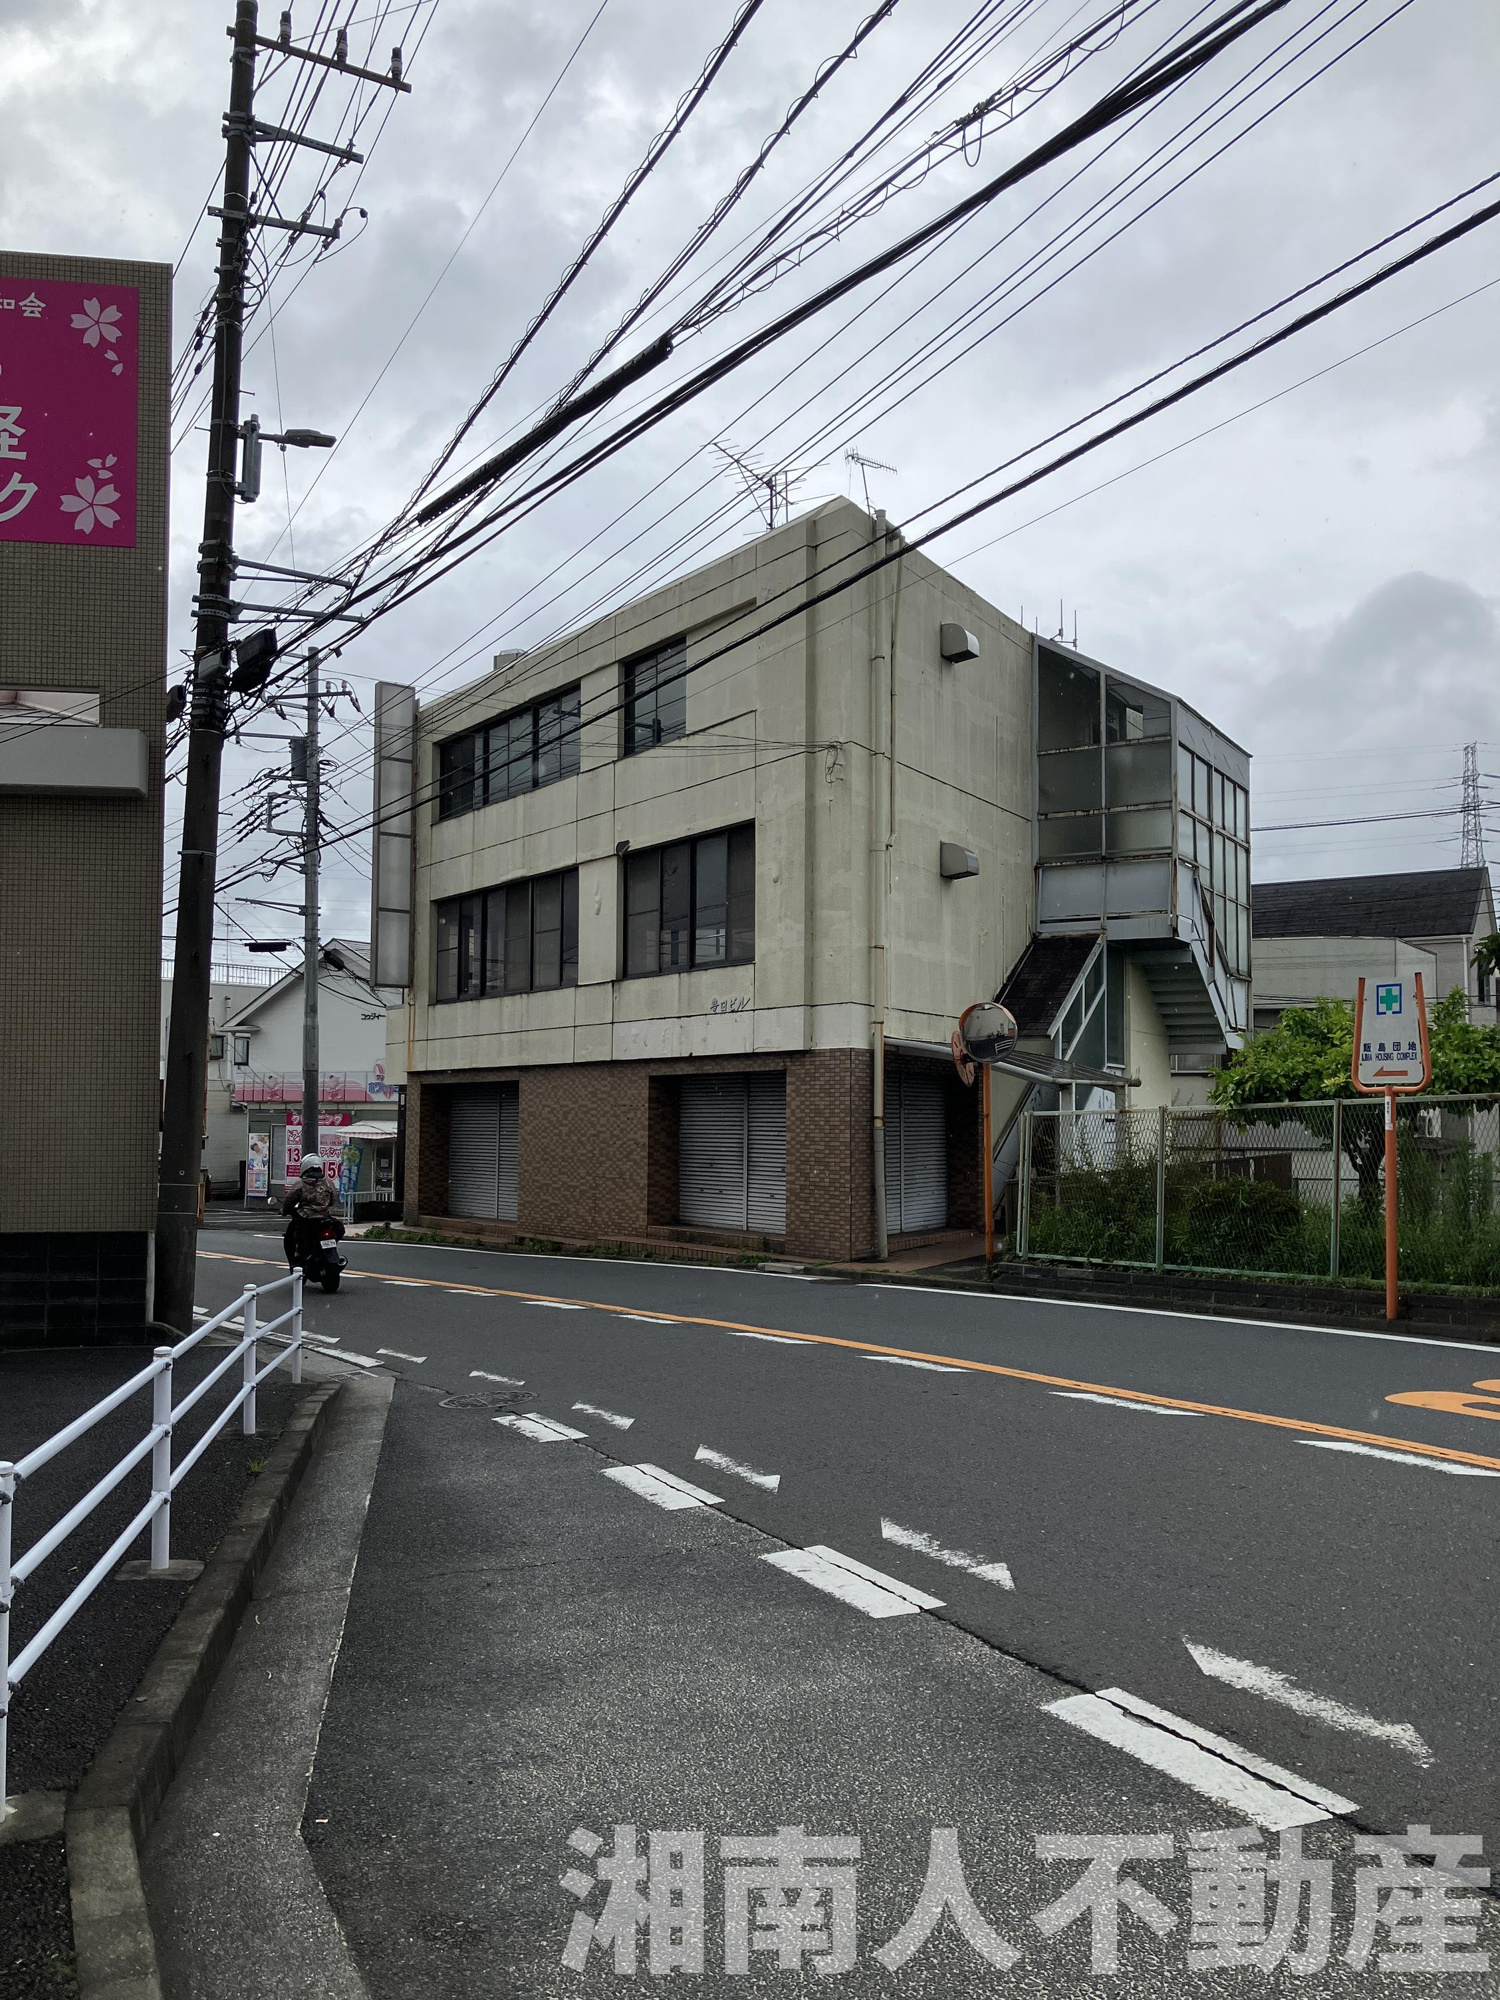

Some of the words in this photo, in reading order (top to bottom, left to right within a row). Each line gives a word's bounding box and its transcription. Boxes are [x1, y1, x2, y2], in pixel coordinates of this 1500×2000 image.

[1375, 1053, 1394, 1061] HOUSING
[1397, 1052, 1417, 1060] COMPLEX
[320, 1147, 342, 1158] ワイシャ
